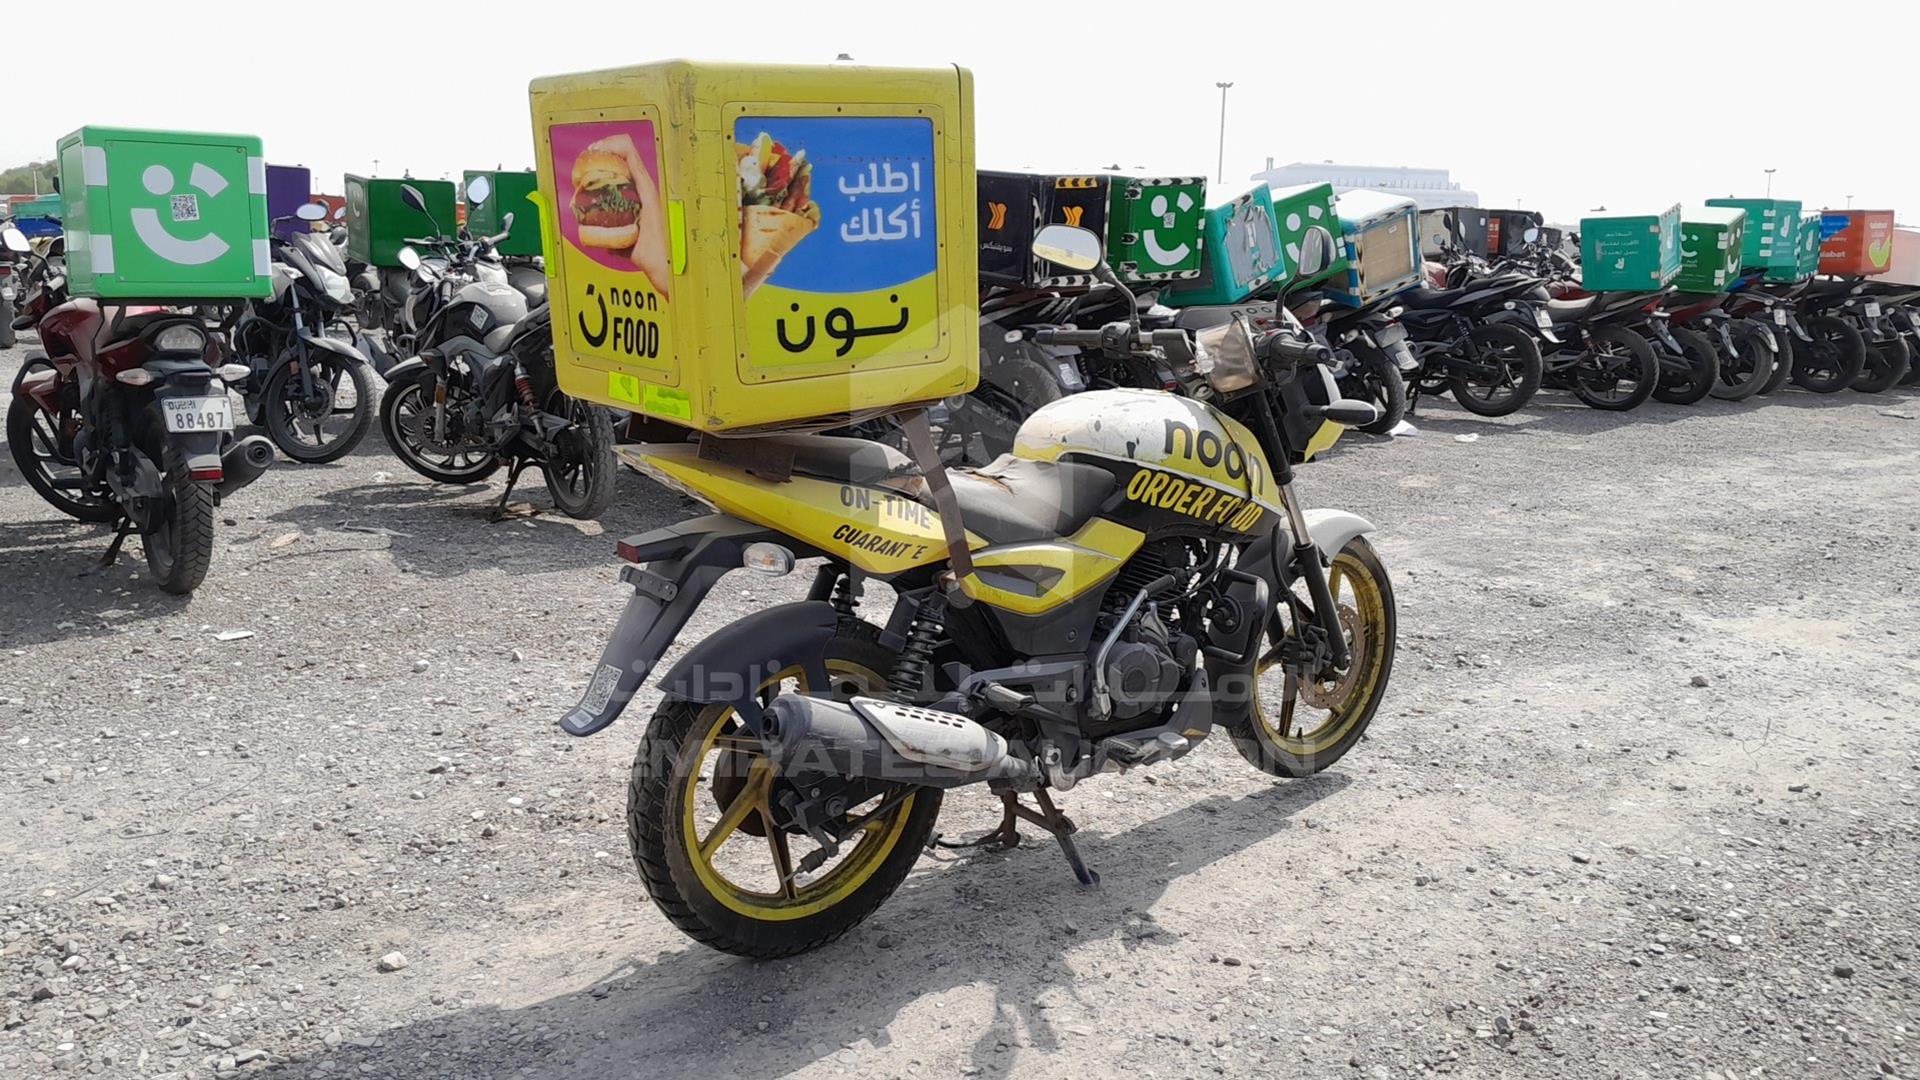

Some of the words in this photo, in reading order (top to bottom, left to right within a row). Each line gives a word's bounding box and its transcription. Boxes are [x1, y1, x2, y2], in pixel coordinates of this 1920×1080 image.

[839, 160, 921, 203] اطلب
[840, 197, 921, 243] أكلك
[610, 287, 657, 311] noon
[613, 316, 659, 359] FOOD
[175, 412, 224, 429] 88487
[1164, 418, 1264, 496] noon
[840, 485, 933, 530] ON-TIME
[1126, 469, 1217, 519] ORDER
